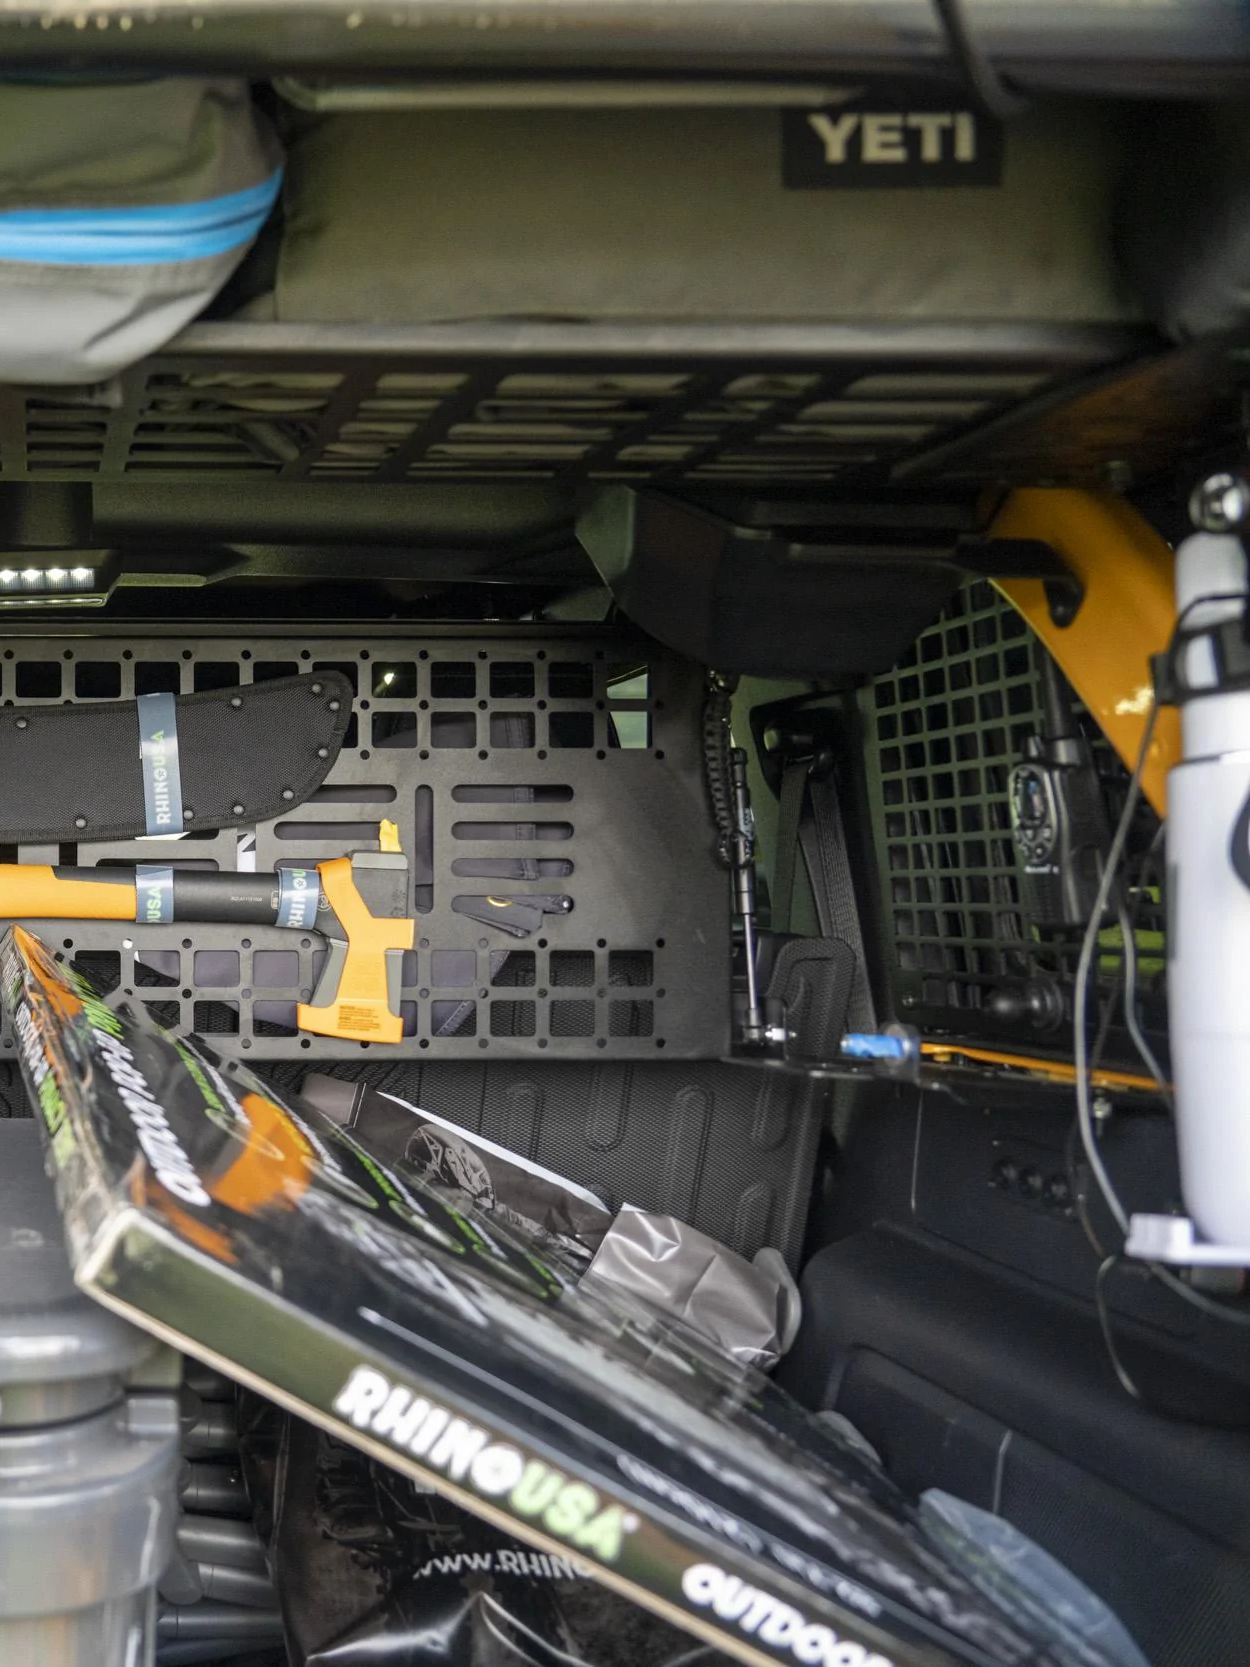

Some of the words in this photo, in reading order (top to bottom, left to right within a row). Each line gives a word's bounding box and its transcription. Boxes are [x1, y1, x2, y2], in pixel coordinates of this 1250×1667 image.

[807, 111, 976, 165] YETI
[150, 729, 172, 826] RHINOUSA
[146, 886, 163, 923] USA
[332, 1364, 624, 1561] RHINOUSA
